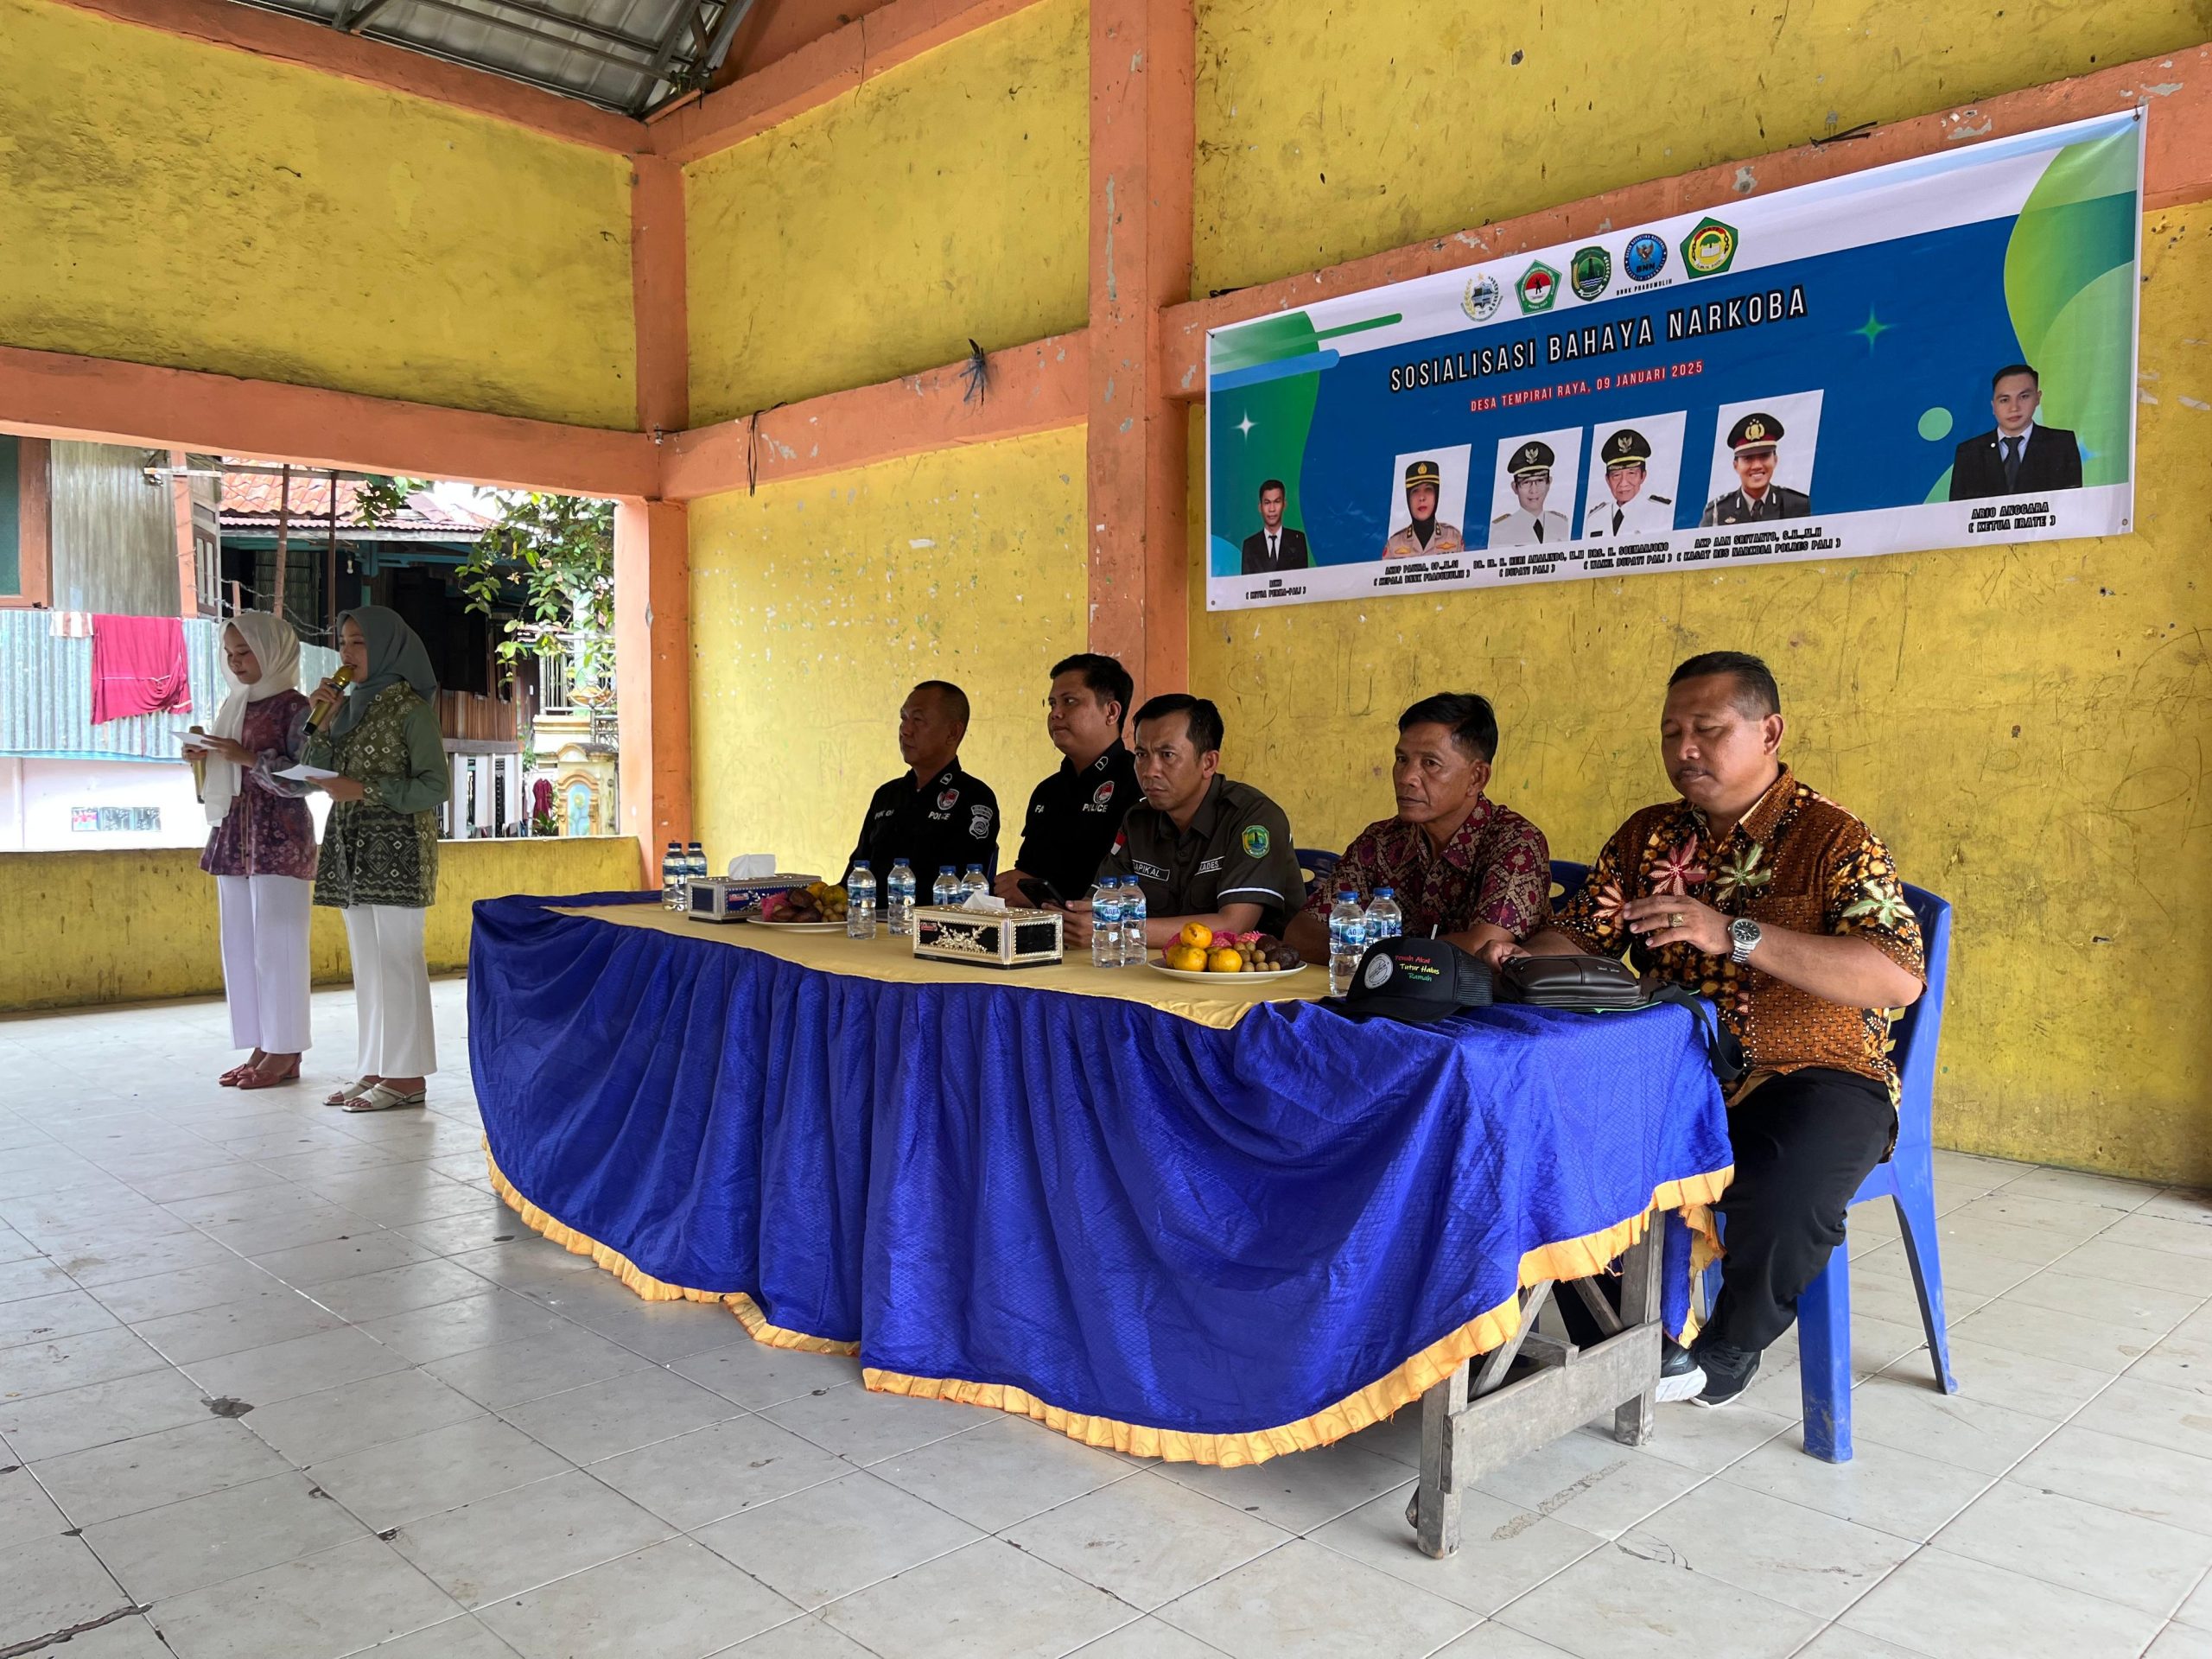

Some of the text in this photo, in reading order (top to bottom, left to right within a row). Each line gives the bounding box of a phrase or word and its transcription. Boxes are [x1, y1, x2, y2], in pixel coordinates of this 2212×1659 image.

[1637, 263, 1656, 273] BNN
[1389, 284, 1808, 393] SOSIALISASI BAHAYA NARKOBA
[1471, 359, 1705, 412] DESA TEMPIRAI RAYA, 09 JANUARI 2025
[1971, 501, 2050, 519] ARIO ANGGARA
[1976, 518, 2012, 532] KETUA
[2014, 515, 2047, 529] IRATE
[1694, 538, 1712, 549] AKP
[1713, 536, 1732, 546] AAN
[1733, 531, 1780, 545] SRIYANTO,
[1683, 550, 1711, 562] KASAT
[1732, 544, 1773, 557] NARKOBA
[1775, 541, 1809, 554] POLRES
[1811, 538, 1834, 550] PALI
[1616, 556, 1645, 567] BUPATI
[1647, 553, 1666, 564] PALI
[1532, 564, 1549, 575] PALI
[1400, 963, 1420, 971] Tutur
